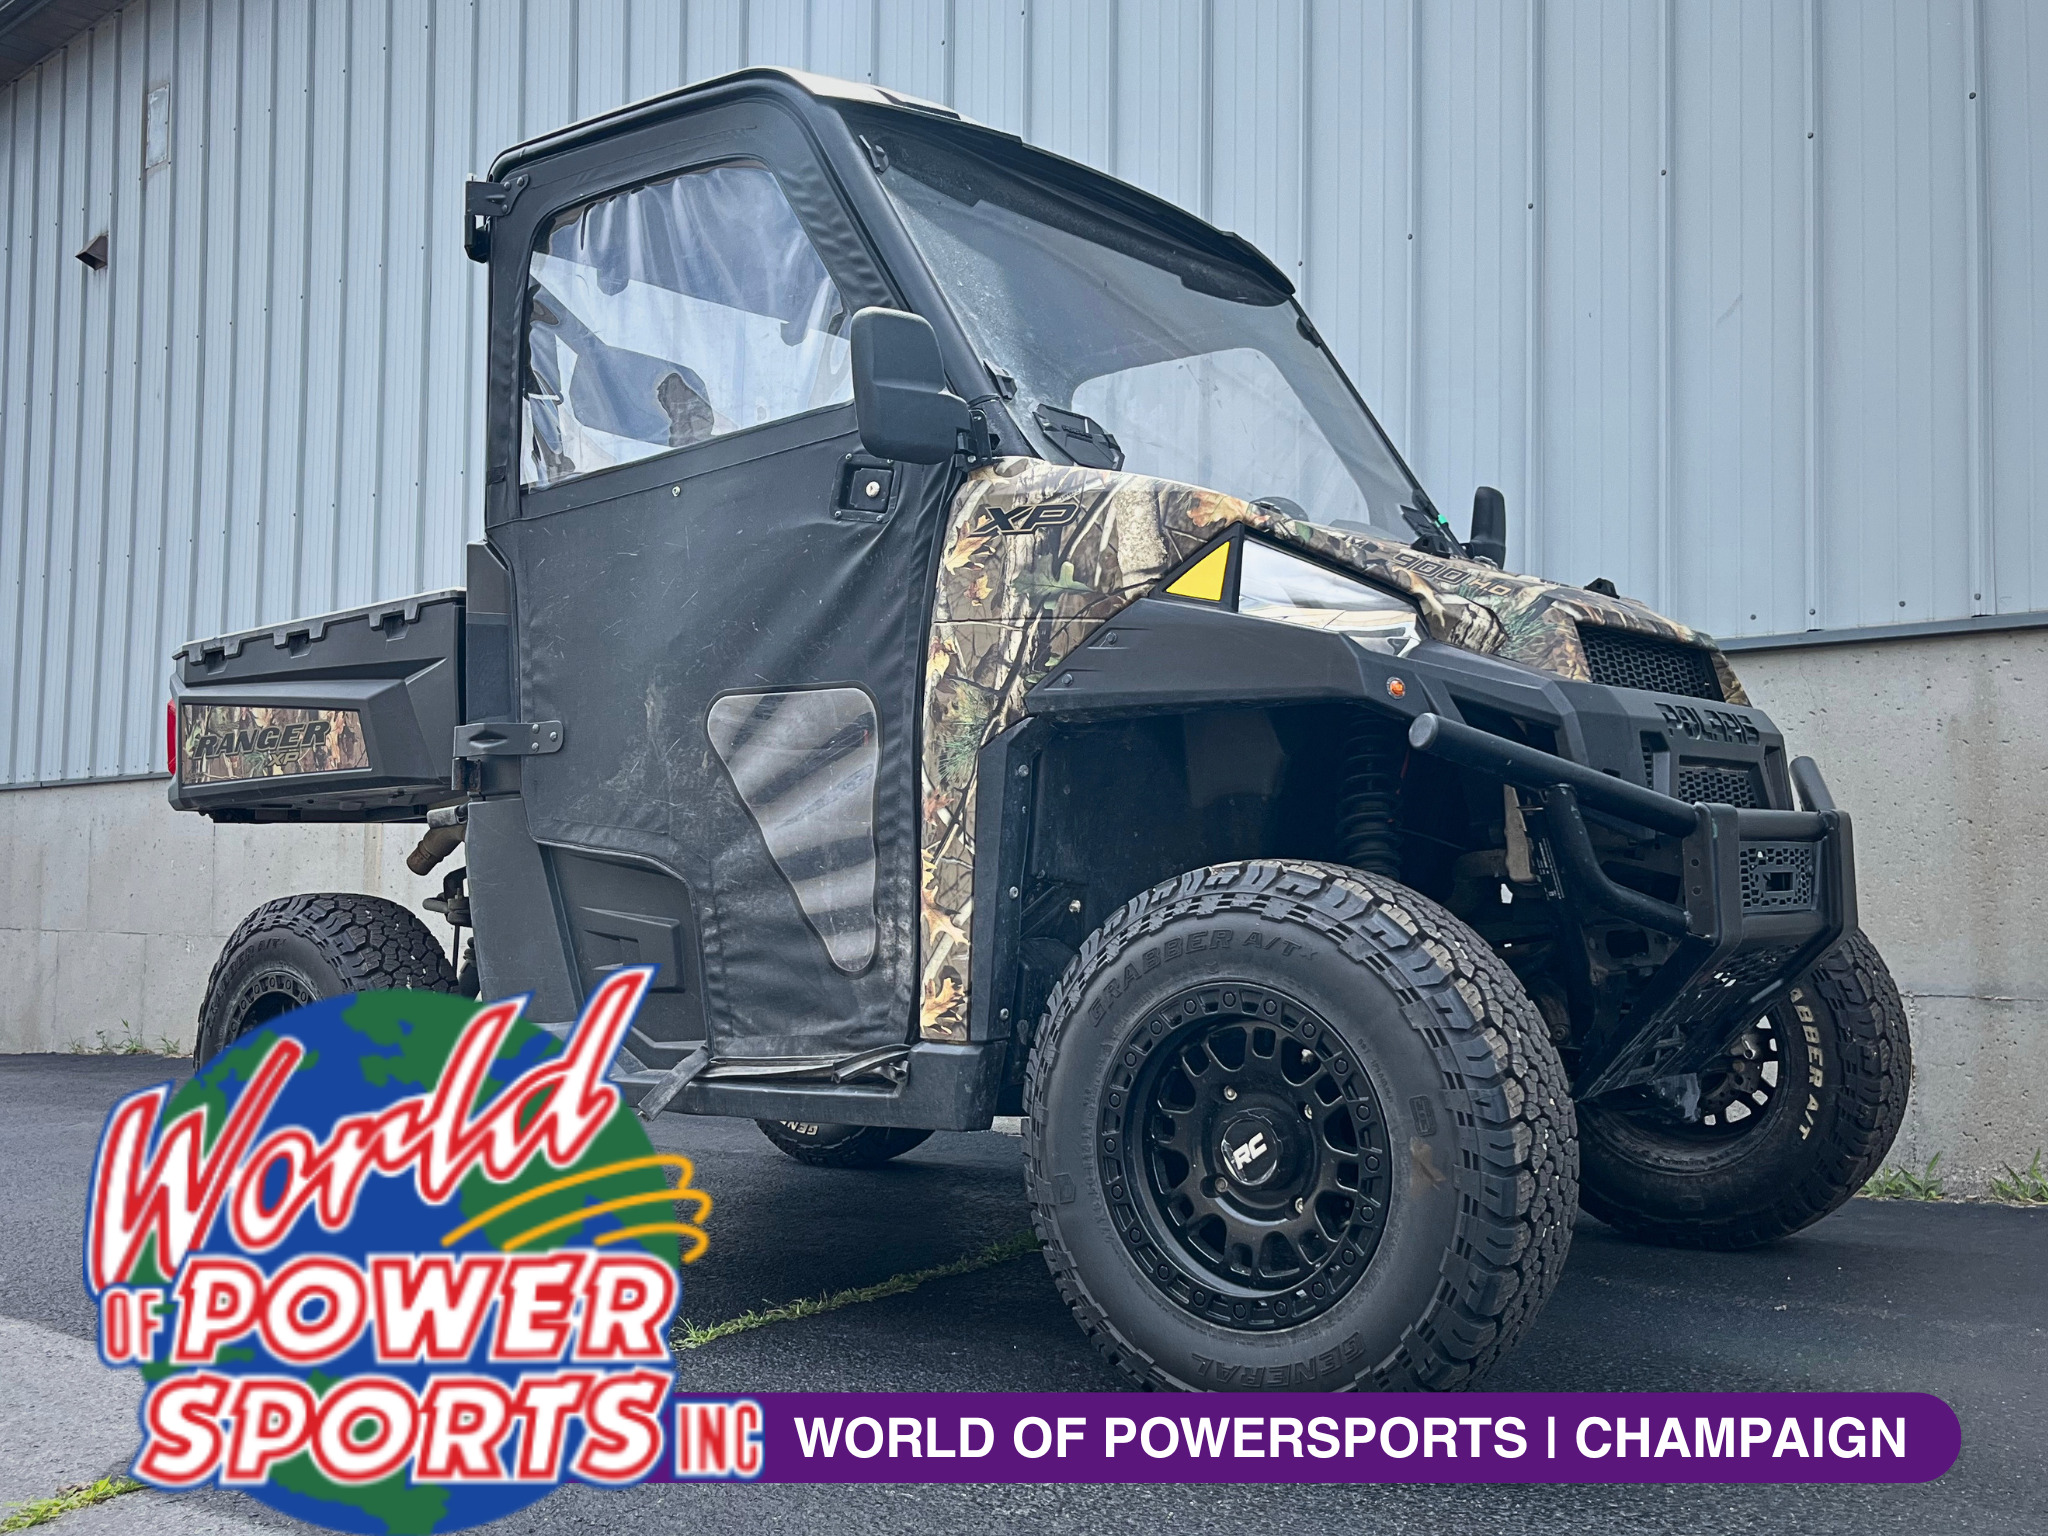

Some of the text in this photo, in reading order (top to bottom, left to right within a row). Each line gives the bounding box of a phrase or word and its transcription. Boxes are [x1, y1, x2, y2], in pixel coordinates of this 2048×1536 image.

[967, 502, 1081, 538] XP
[1393, 553, 1472, 585] 900
[192, 719, 332, 761] RANGER
[1653, 702, 1760, 746] POLARIS
[266, 751, 300, 767] XP
[1088, 928, 1234, 1028] GRABBER
[1799, 1094, 1820, 1141] A/T
[1232, 1132, 1268, 1170] RC
[1191, 1331, 1366, 1389] GENERAL
